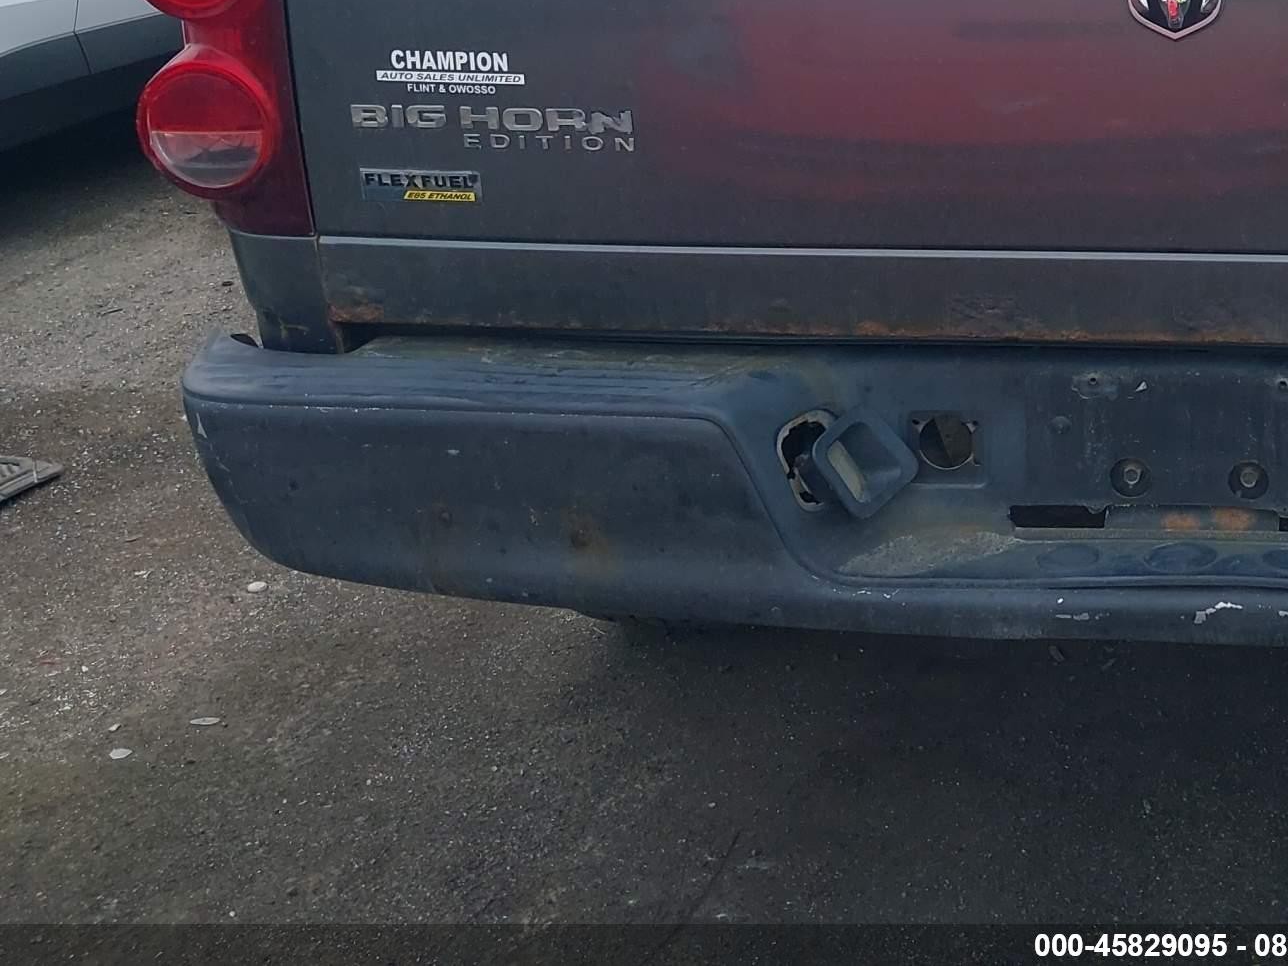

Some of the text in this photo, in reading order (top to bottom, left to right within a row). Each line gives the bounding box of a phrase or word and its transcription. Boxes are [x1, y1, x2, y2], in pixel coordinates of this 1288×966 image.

[390, 49, 509, 72] CHAMPION
[381, 72, 521, 83] AUTO SALES UNLIMITED
[407, 84, 496, 94] FLINT & OWOSSO
[350, 104, 633, 134] BIG HORN
[463, 133, 635, 152] EDITION
[363, 172, 474, 189] FLEXFUEL
[428, 192, 472, 200] ETHANOL
